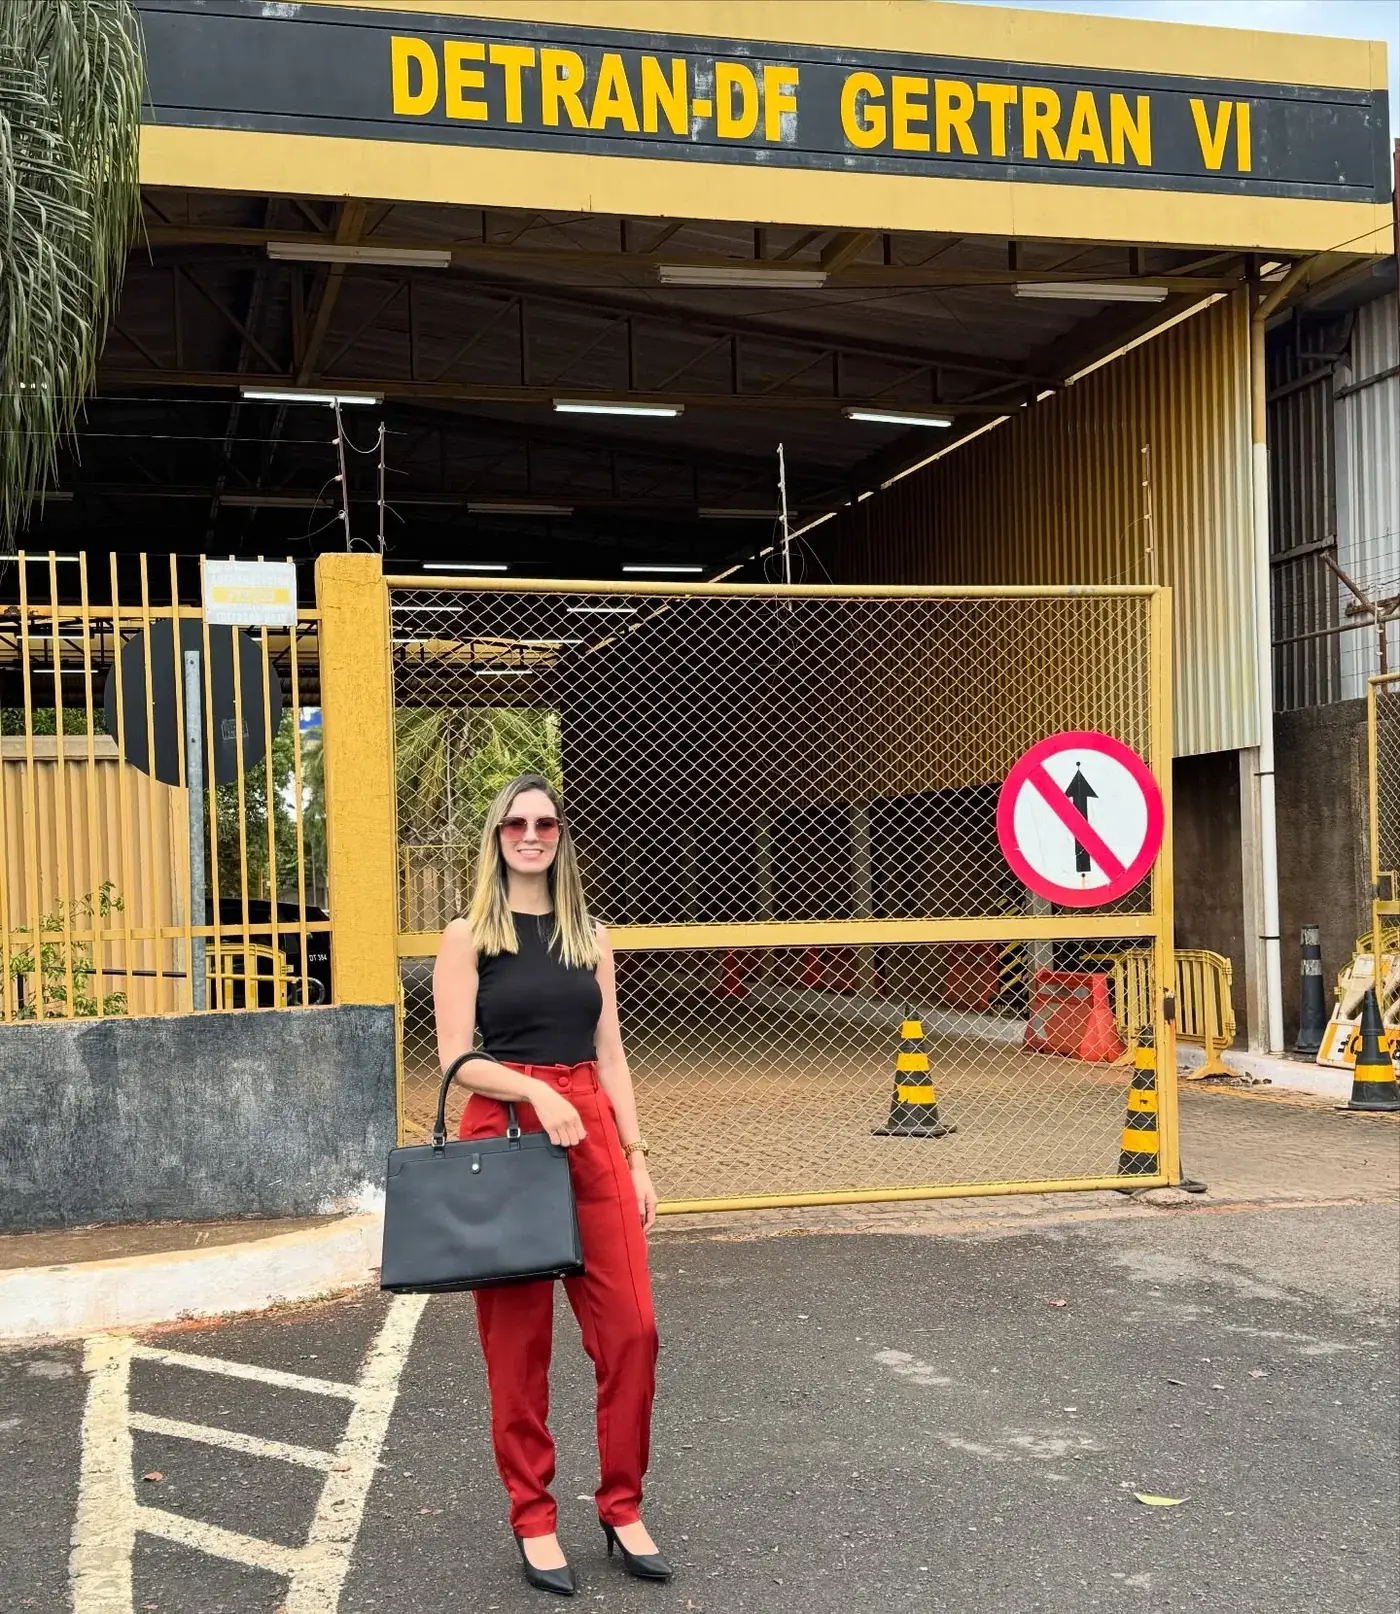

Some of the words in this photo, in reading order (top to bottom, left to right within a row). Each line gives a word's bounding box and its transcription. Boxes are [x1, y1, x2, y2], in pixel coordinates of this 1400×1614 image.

[391, 36, 799, 142] DETRAN-DF
[841, 71, 1151, 166] GERTRAN
[1189, 98, 1251, 171] VI
